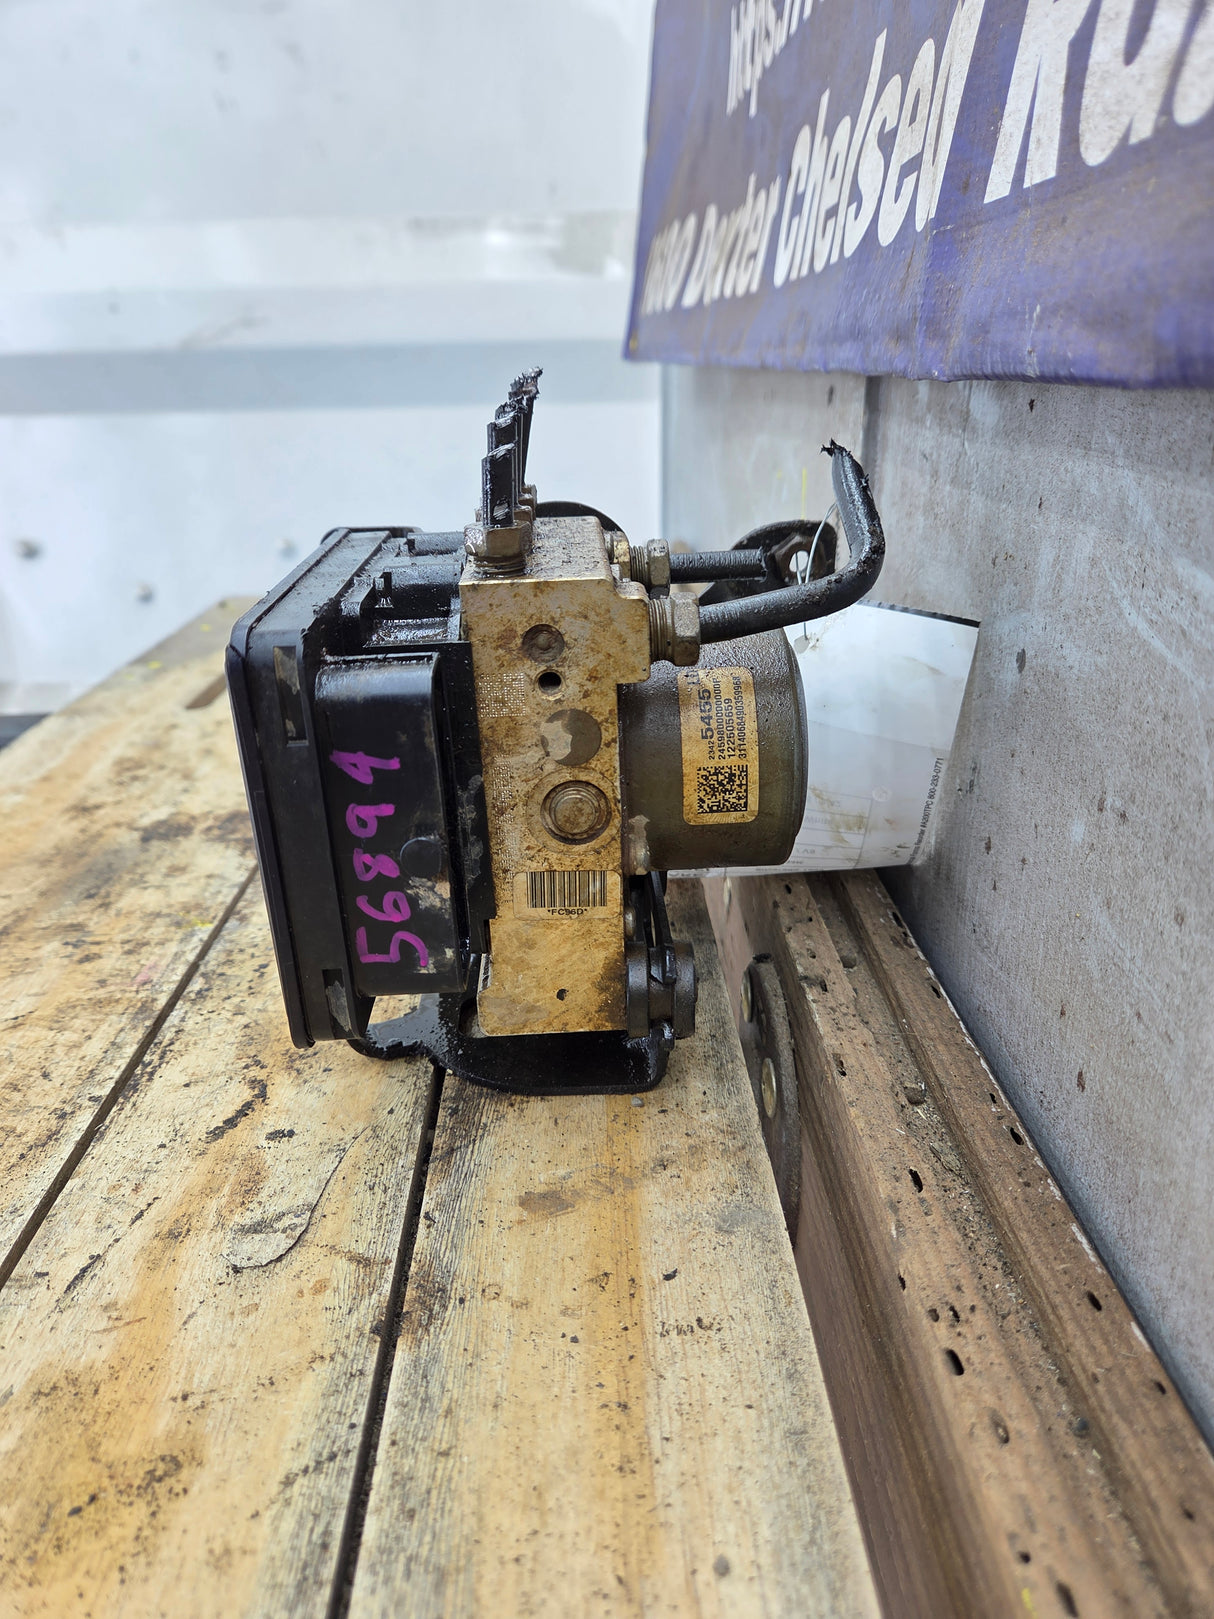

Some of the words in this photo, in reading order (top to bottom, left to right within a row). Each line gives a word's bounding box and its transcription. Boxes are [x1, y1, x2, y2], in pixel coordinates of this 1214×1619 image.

[774, 0, 984, 288] Chelsea
[698, 688, 715, 740] 5455
[724, 698, 736, 759] 122505659
[330, 750, 429, 968] 56894
